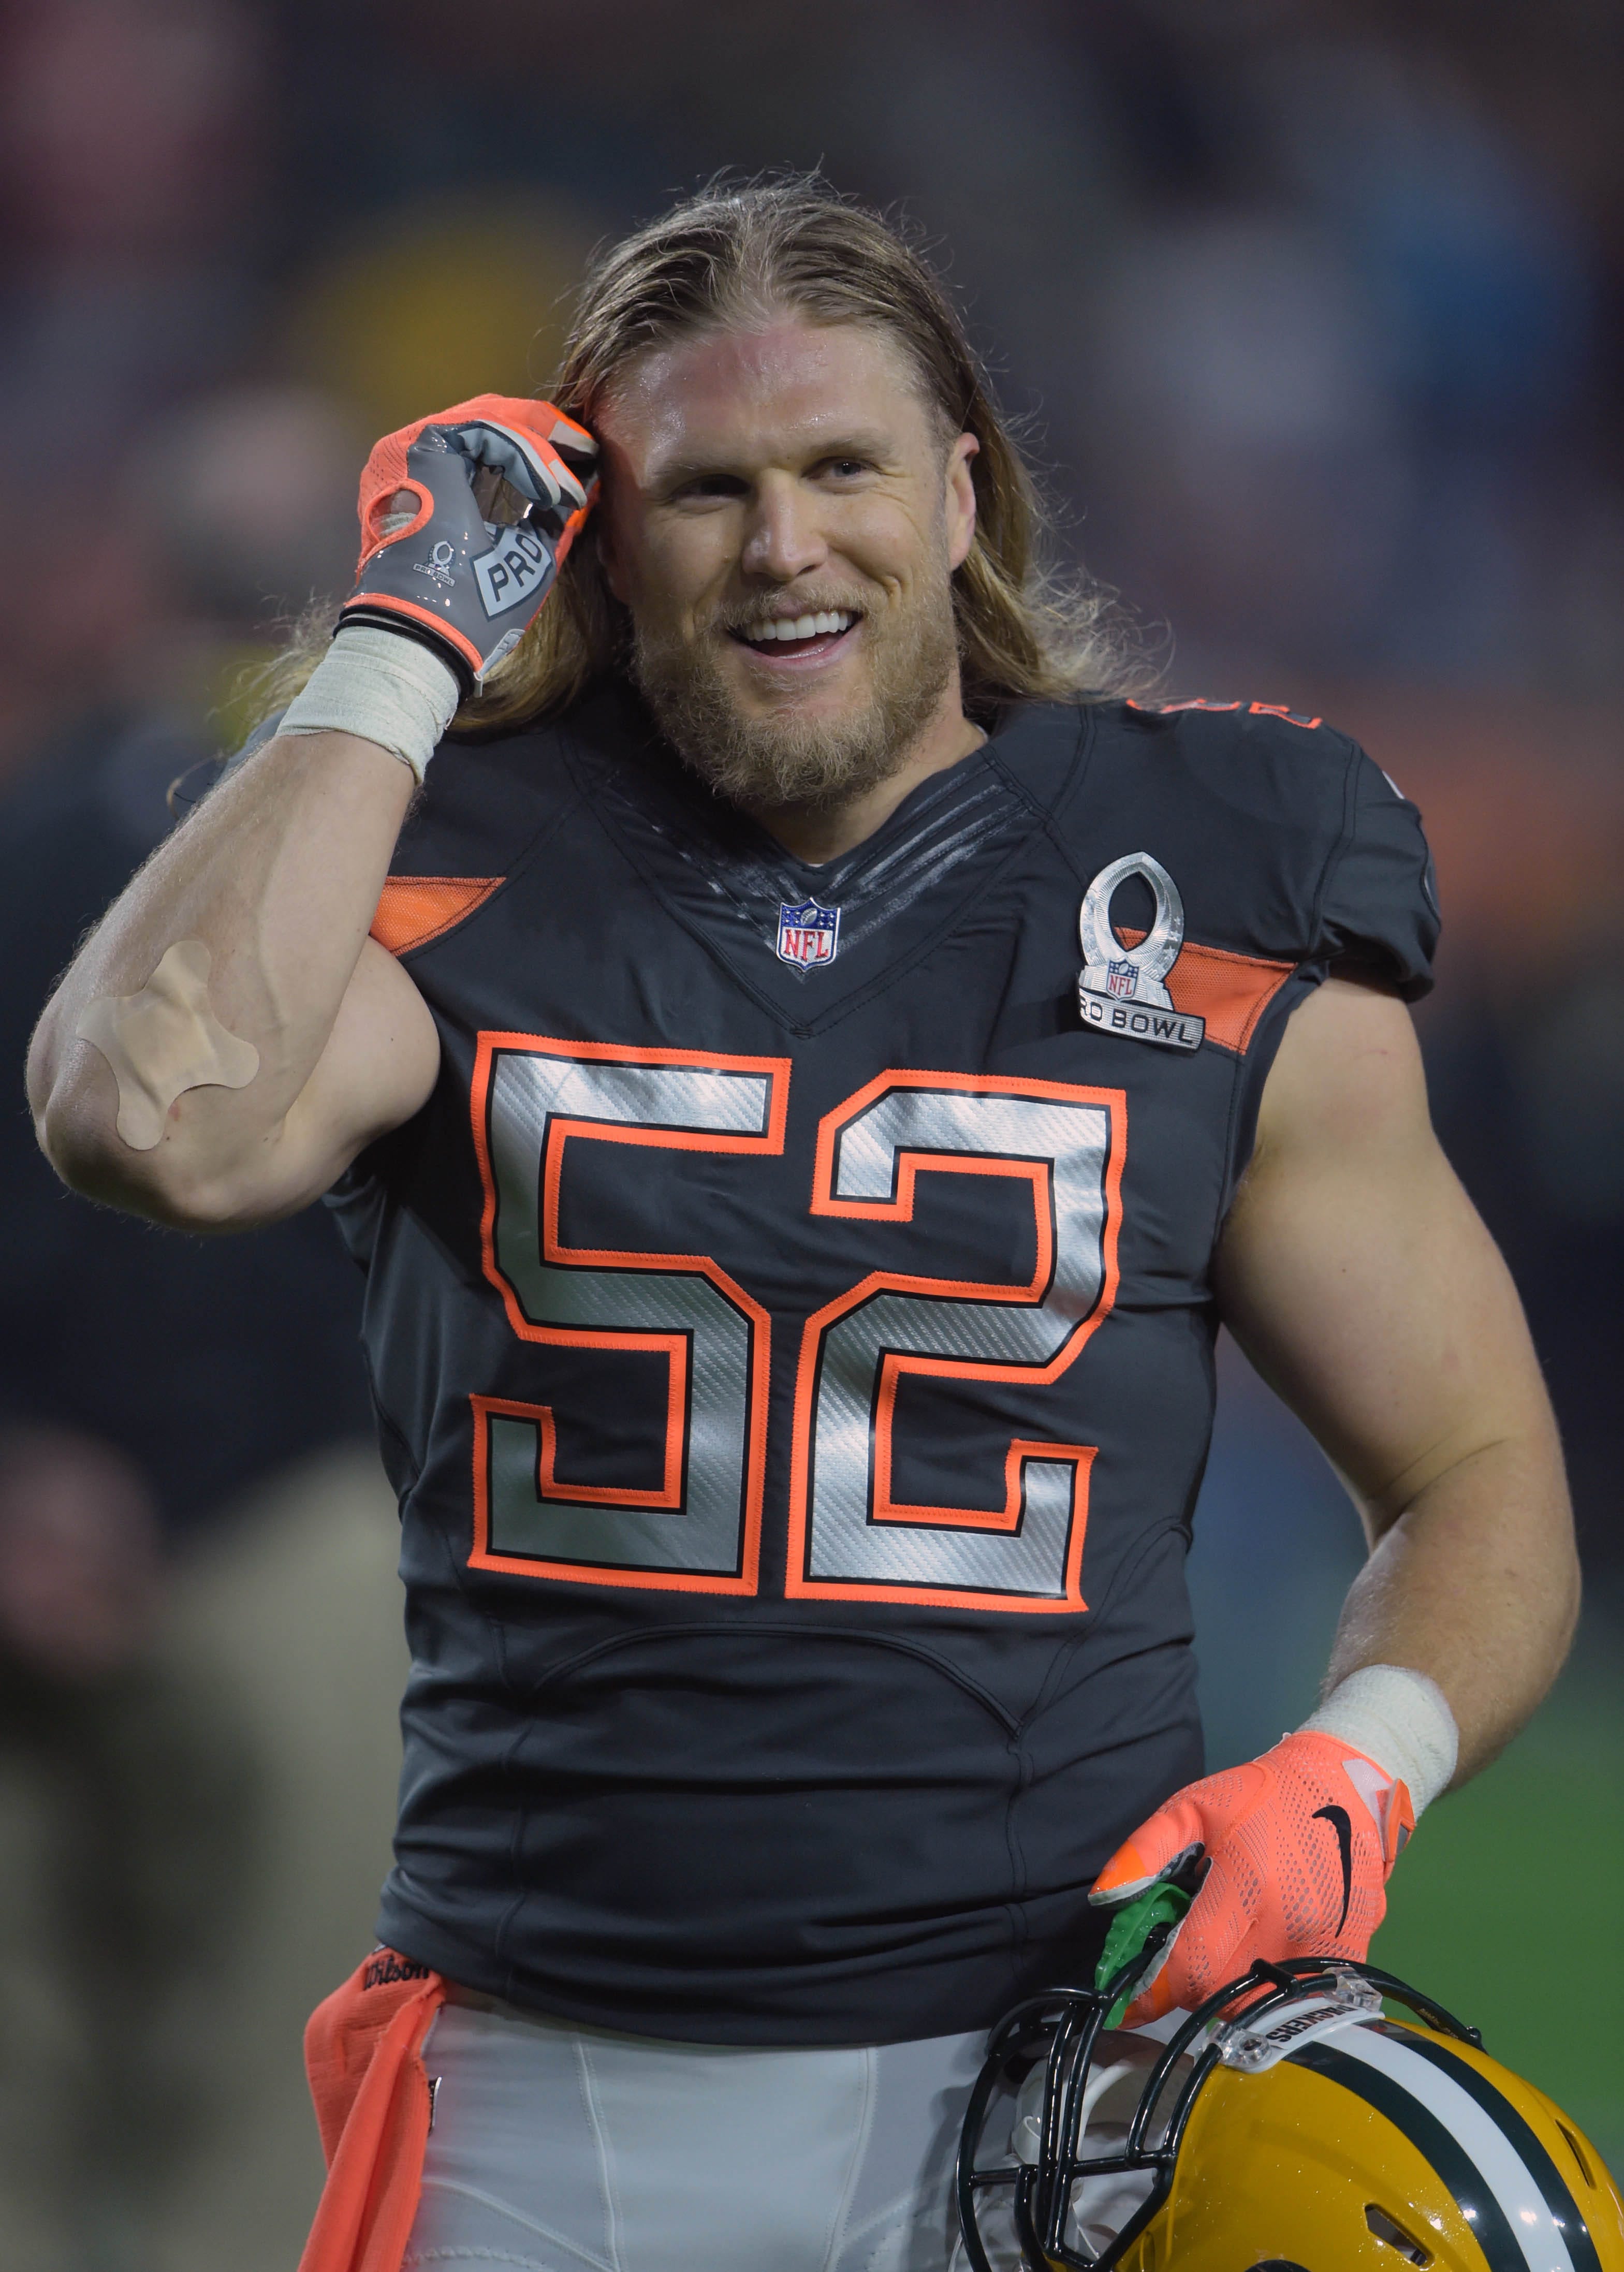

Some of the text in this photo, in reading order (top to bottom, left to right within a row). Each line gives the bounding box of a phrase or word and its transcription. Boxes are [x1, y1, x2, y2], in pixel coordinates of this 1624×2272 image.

[415, 565, 452, 585] PRO BOWL
[487, 533, 542, 602] PRO
[783, 929, 828, 962] NFL
[1108, 974, 1132, 996] NFL
[1080, 996, 1193, 1043] RO BOWL
[467, 1031, 1126, 1613] 52
[1265, 2004, 1359, 2043] PACKERS
